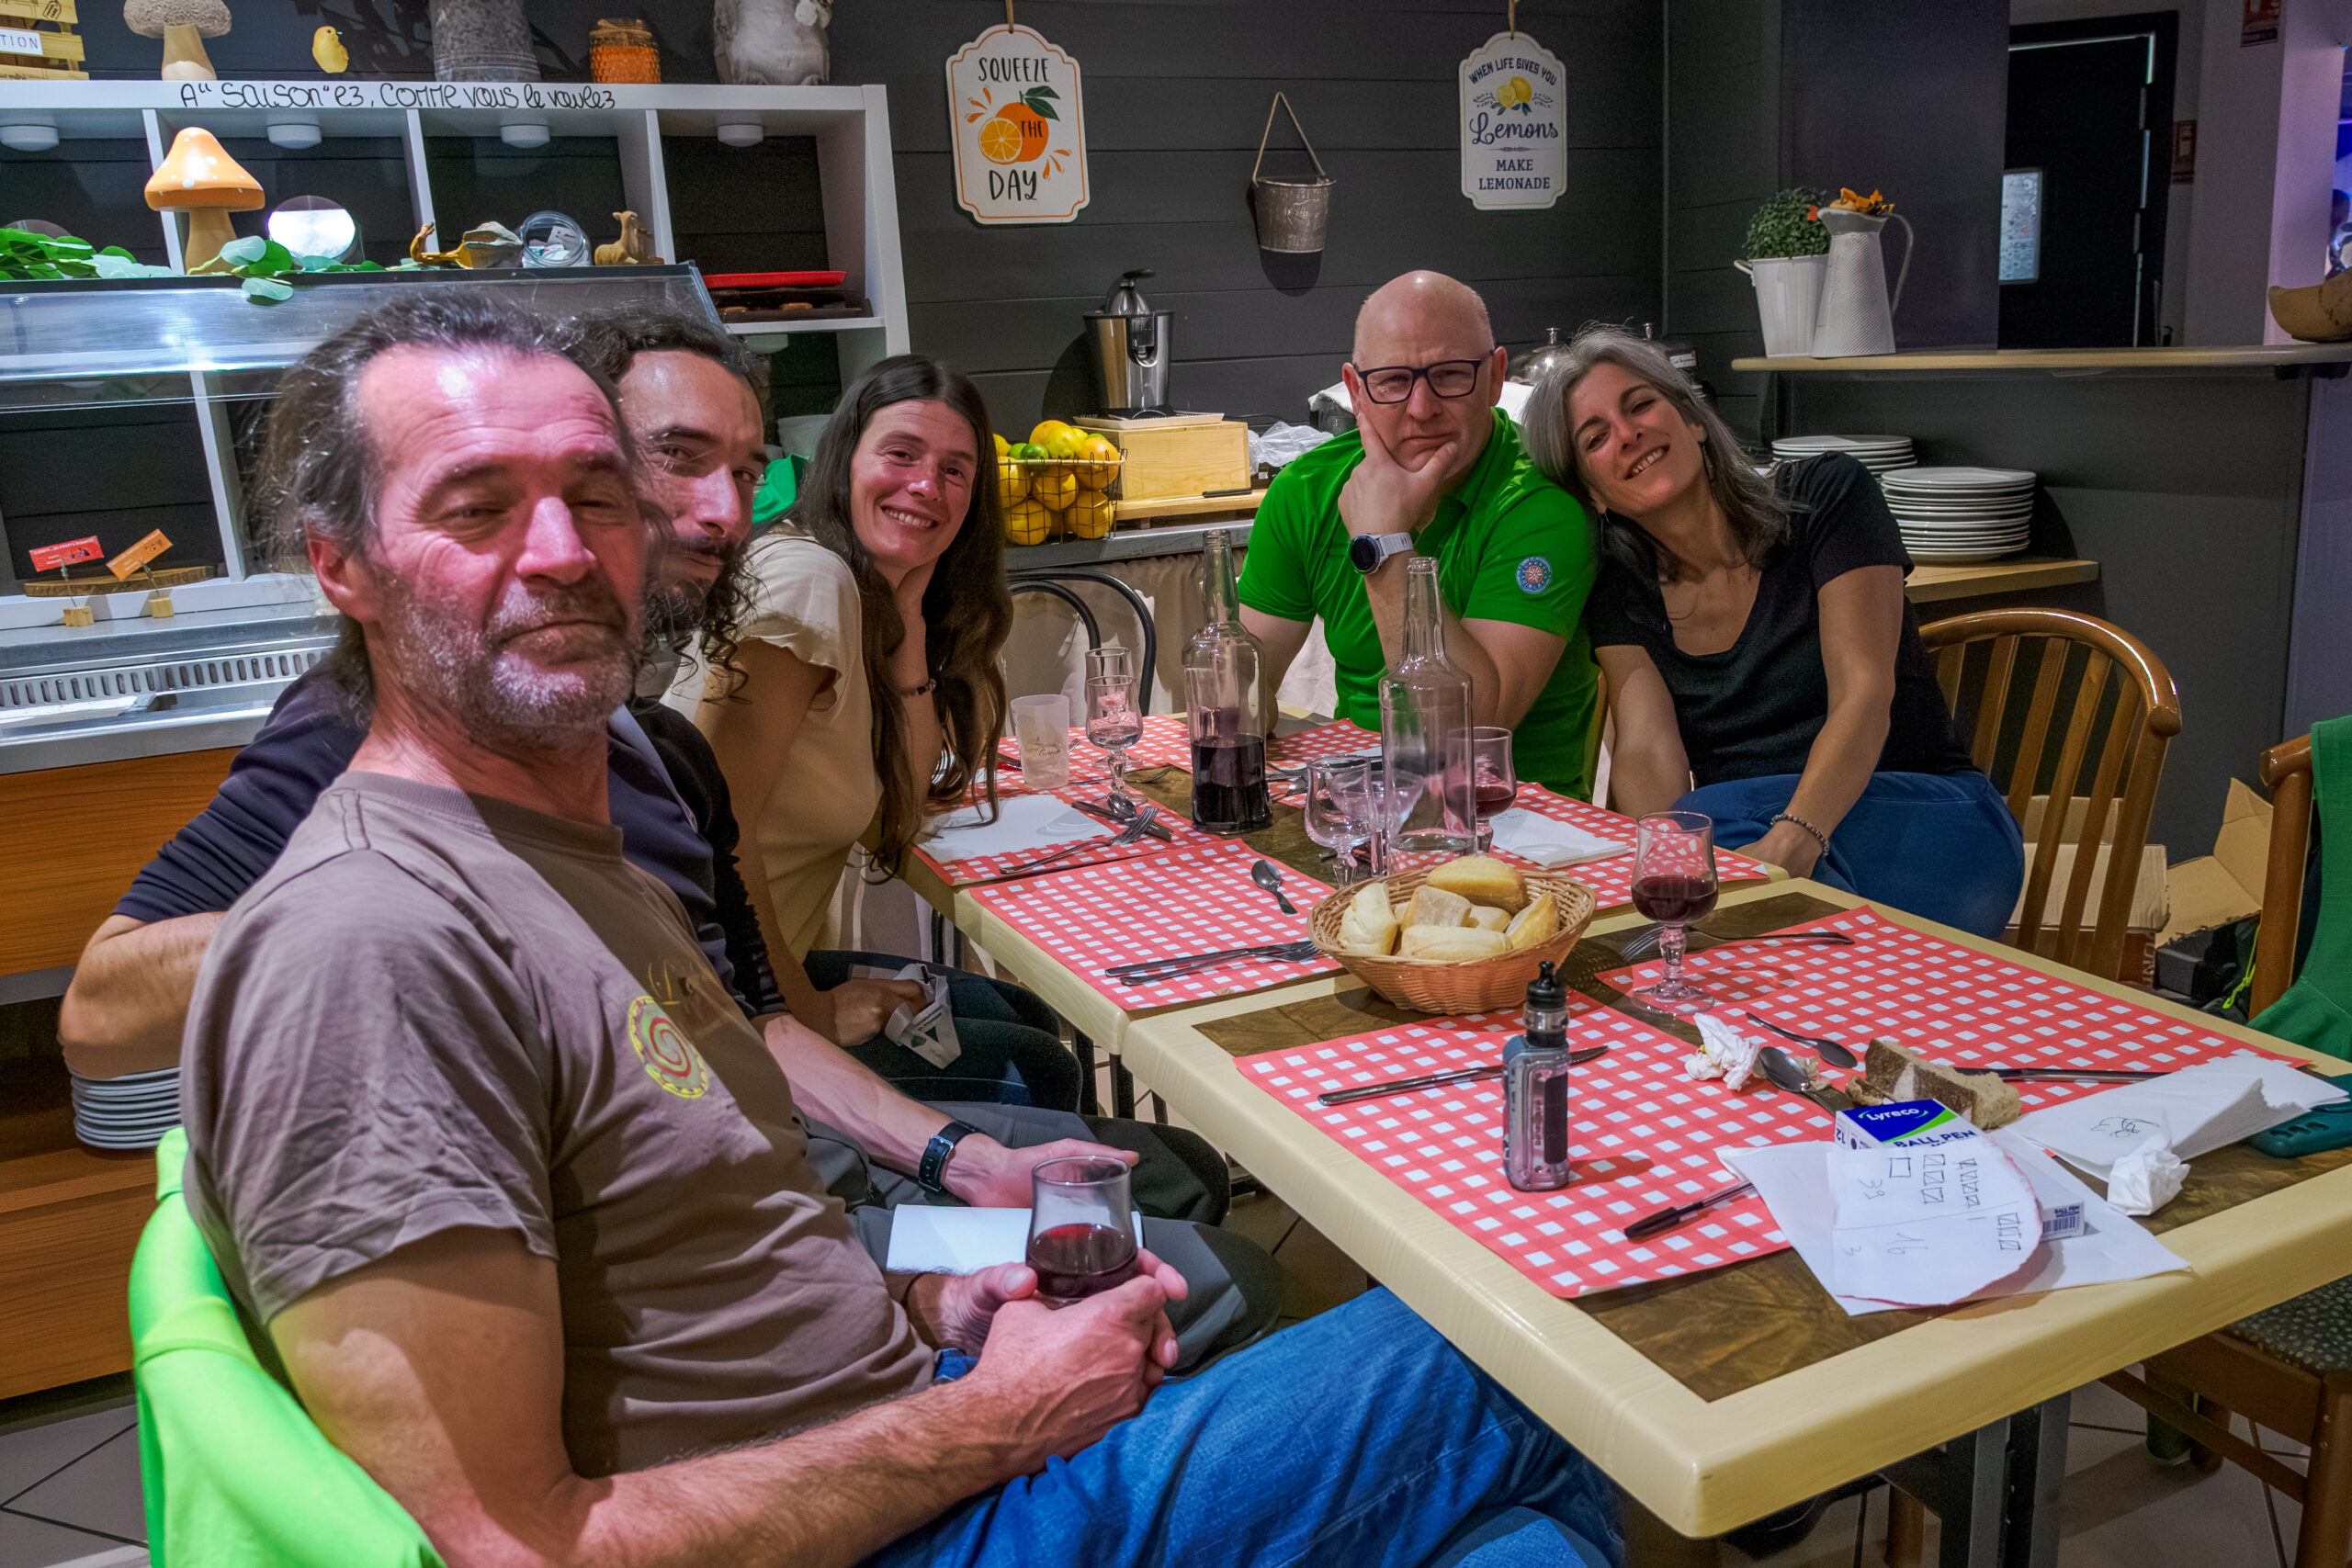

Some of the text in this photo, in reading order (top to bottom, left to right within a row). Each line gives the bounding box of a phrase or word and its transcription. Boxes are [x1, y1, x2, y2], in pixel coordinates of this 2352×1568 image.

[978, 57, 1050, 84] SQUEEZE
[1468, 58, 1558, 86] WHEN LIFE GIVES YOU
[463, 86, 519, 108] vous
[524, 84, 545, 108] le
[548, 85, 616, 108] voulez
[1021, 120, 1043, 139] THE
[1469, 112, 1558, 145] Lemons
[1496, 159, 1533, 172] MAKE
[989, 169, 1037, 201] DAY
[1479, 177, 1551, 190] LEMONADE
[1866, 1108, 1920, 1122] Lyreco
[1894, 1136, 1939, 1148] BALL
[1940, 1130, 1977, 1141] PEN
